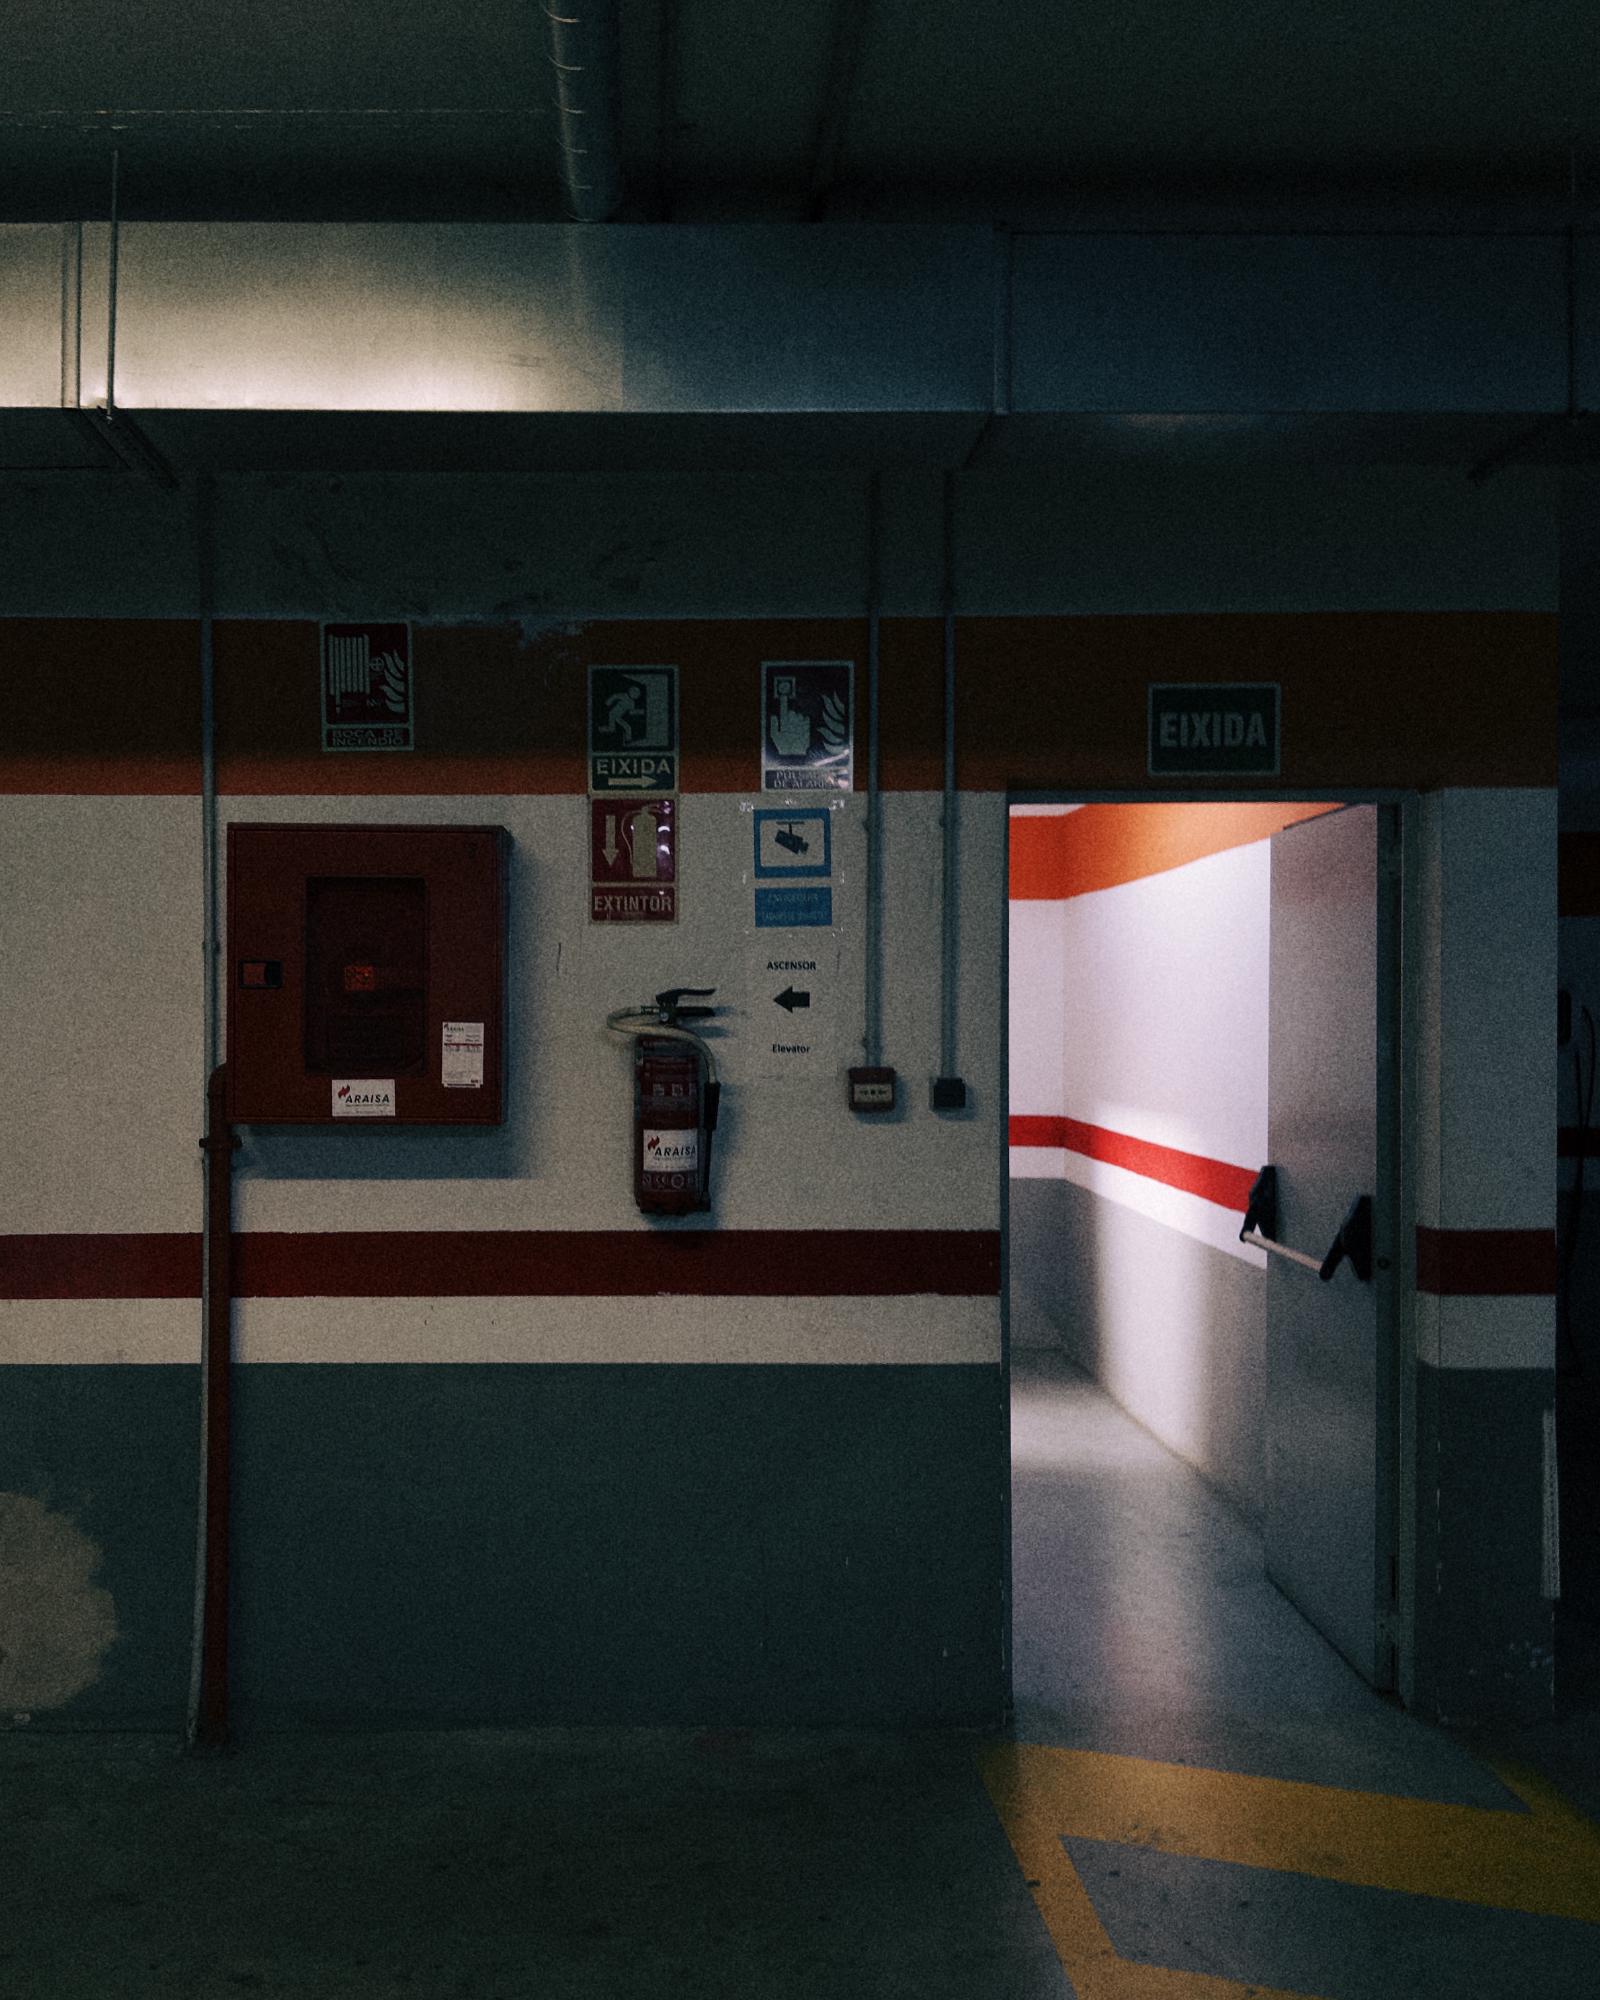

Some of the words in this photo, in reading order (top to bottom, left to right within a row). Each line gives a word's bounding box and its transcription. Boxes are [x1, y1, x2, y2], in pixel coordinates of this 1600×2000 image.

[383, 729, 402, 738] DE
[1159, 711, 1267, 748] EIXIDA
[332, 737, 405, 746] INCENDIO
[596, 758, 672, 775] EIXIDA
[594, 895, 672, 912] EXTINTOR
[767, 961, 816, 970] ASCENSOR
[772, 1044, 810, 1053] Elevator
[345, 1094, 390, 1104] ARAISA
[654, 1146, 696, 1157] ARAISA
